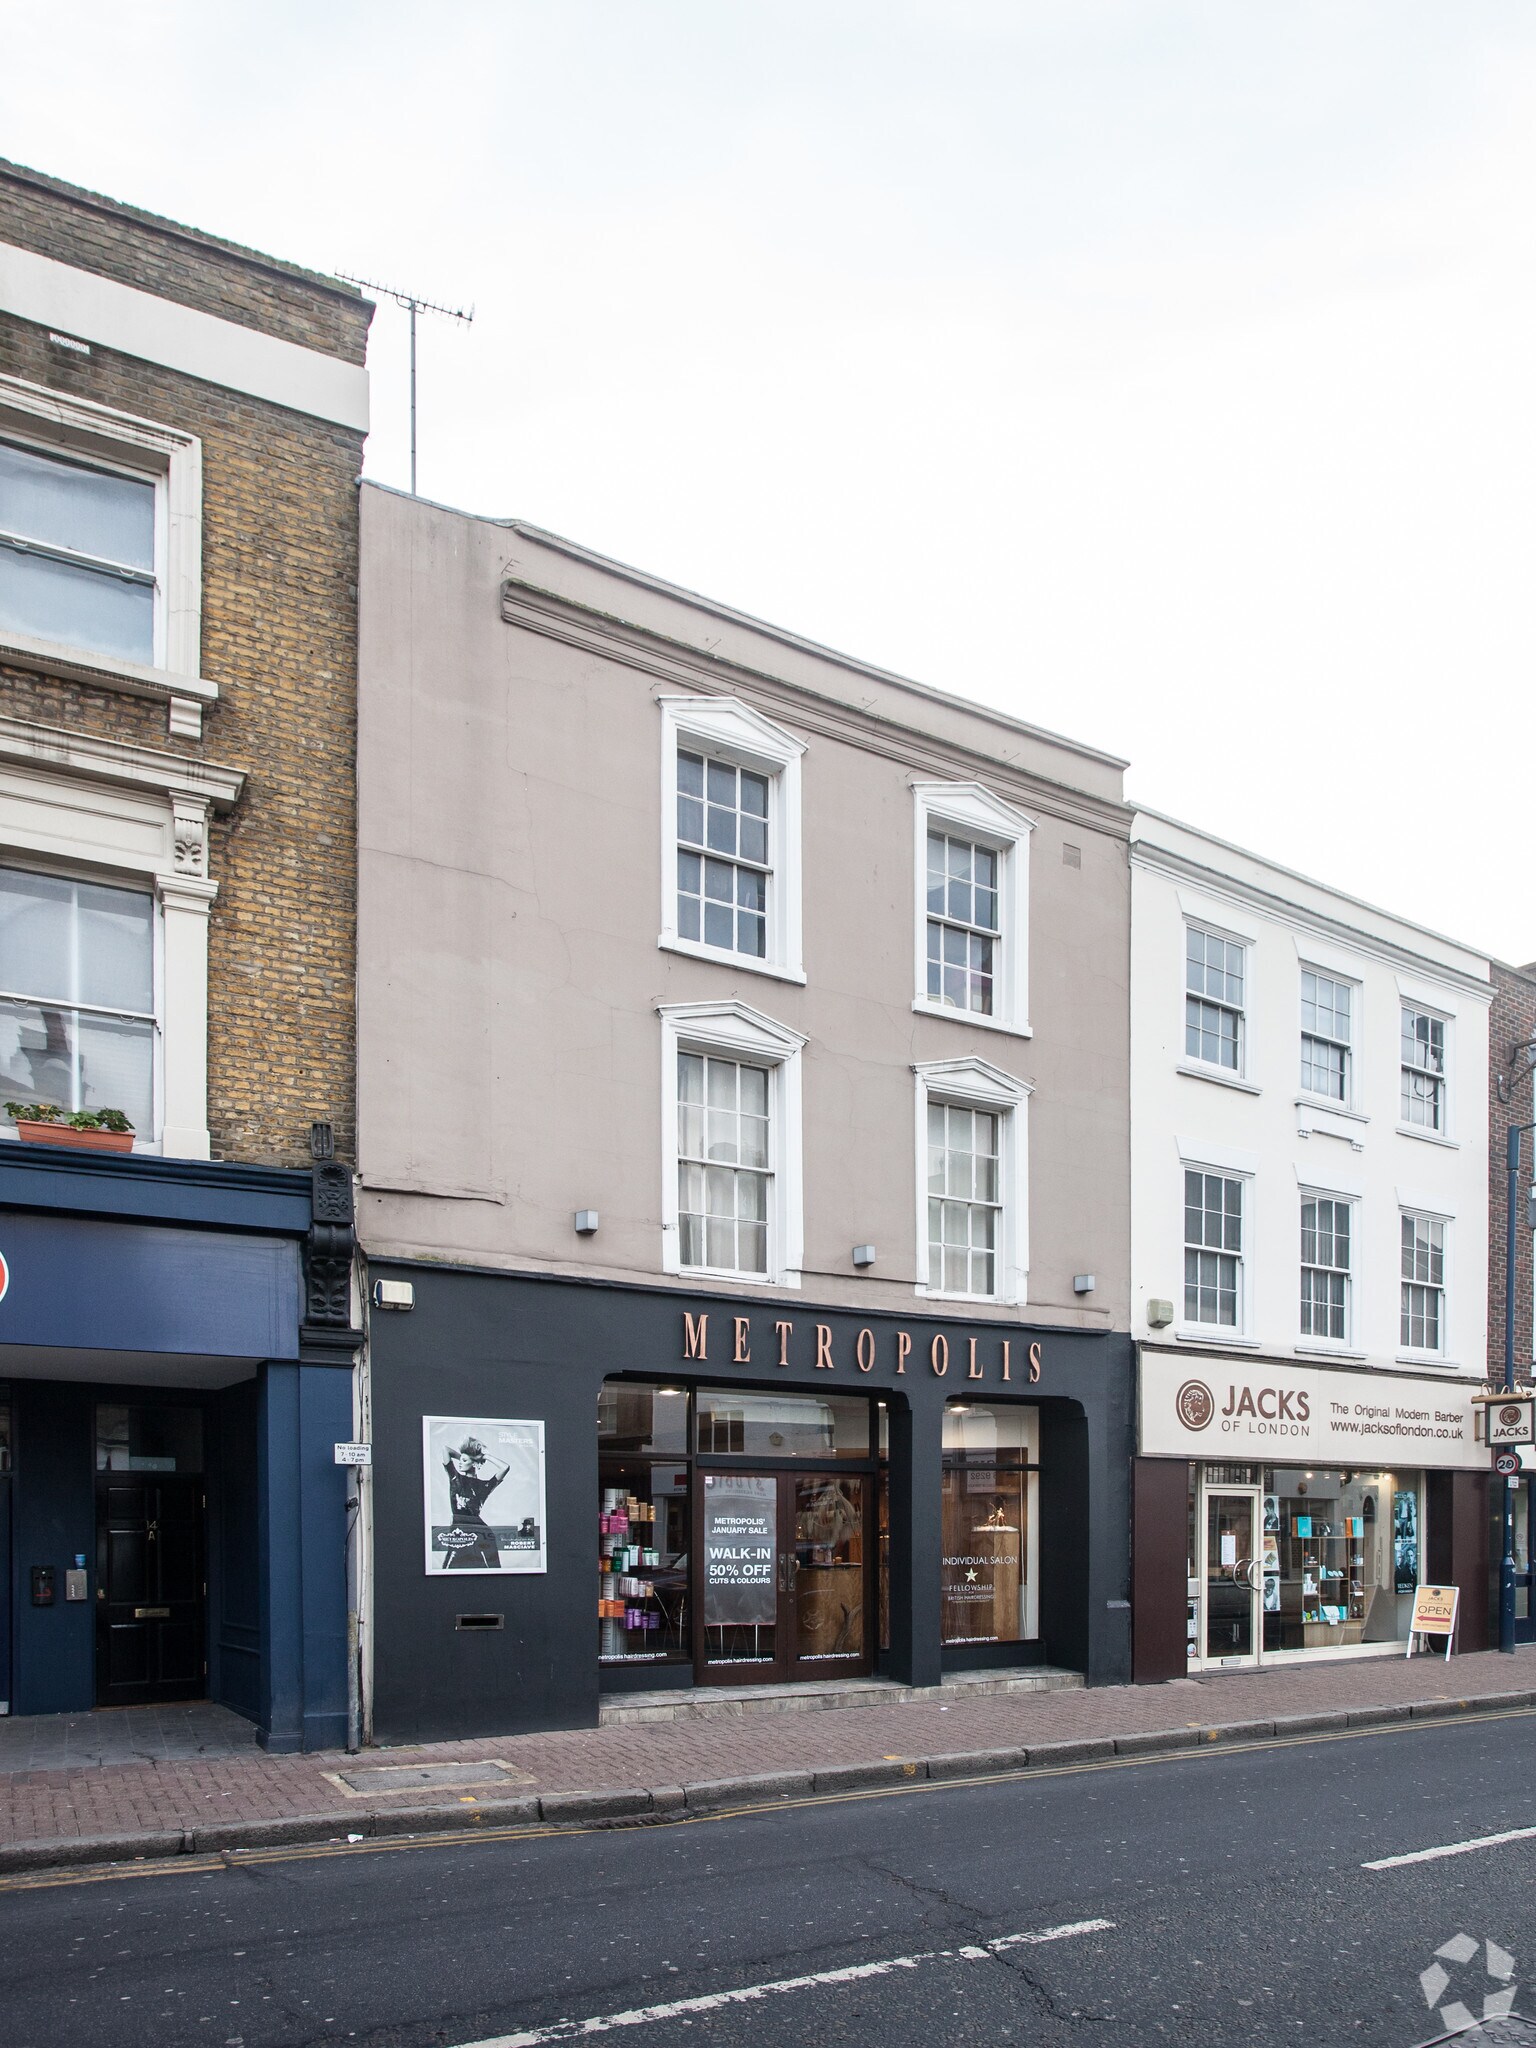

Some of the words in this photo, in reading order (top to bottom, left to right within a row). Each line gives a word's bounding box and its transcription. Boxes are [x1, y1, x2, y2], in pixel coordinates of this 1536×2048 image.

[683, 1312, 1042, 1383] METROPOLIS
[1221, 1385, 1310, 1422] JACKS
[1330, 1402, 1349, 1415] The
[1354, 1404, 1390, 1419] Original
[1395, 1407, 1430, 1421] Modern
[1434, 1411, 1464, 1423] Barber
[1221, 1420, 1240, 1432] OF
[1248, 1421, 1310, 1437] LONDON
[1330, 1421, 1463, 1440] www.jacksoflondon.co.uk
[1493, 1426, 1529, 1438] JACKS
[1498, 1459, 1514, 1469] 20
[714, 1517, 766, 1525] METROPOLIS'
[147, 1530, 156, 1541] A
[711, 1526, 747, 1534] JANUARY
[709, 1547, 771, 1560] WALK-IN
[942, 1556, 989, 1566] INDIVIDUAL
[990, 1555, 1018, 1565] SALON
[709, 1564, 739, 1576] 50%
[742, 1564, 771, 1576] OFF
[948, 1583, 993, 1592] FELLOWSHIP
[1417, 1605, 1452, 1615] OPEN
